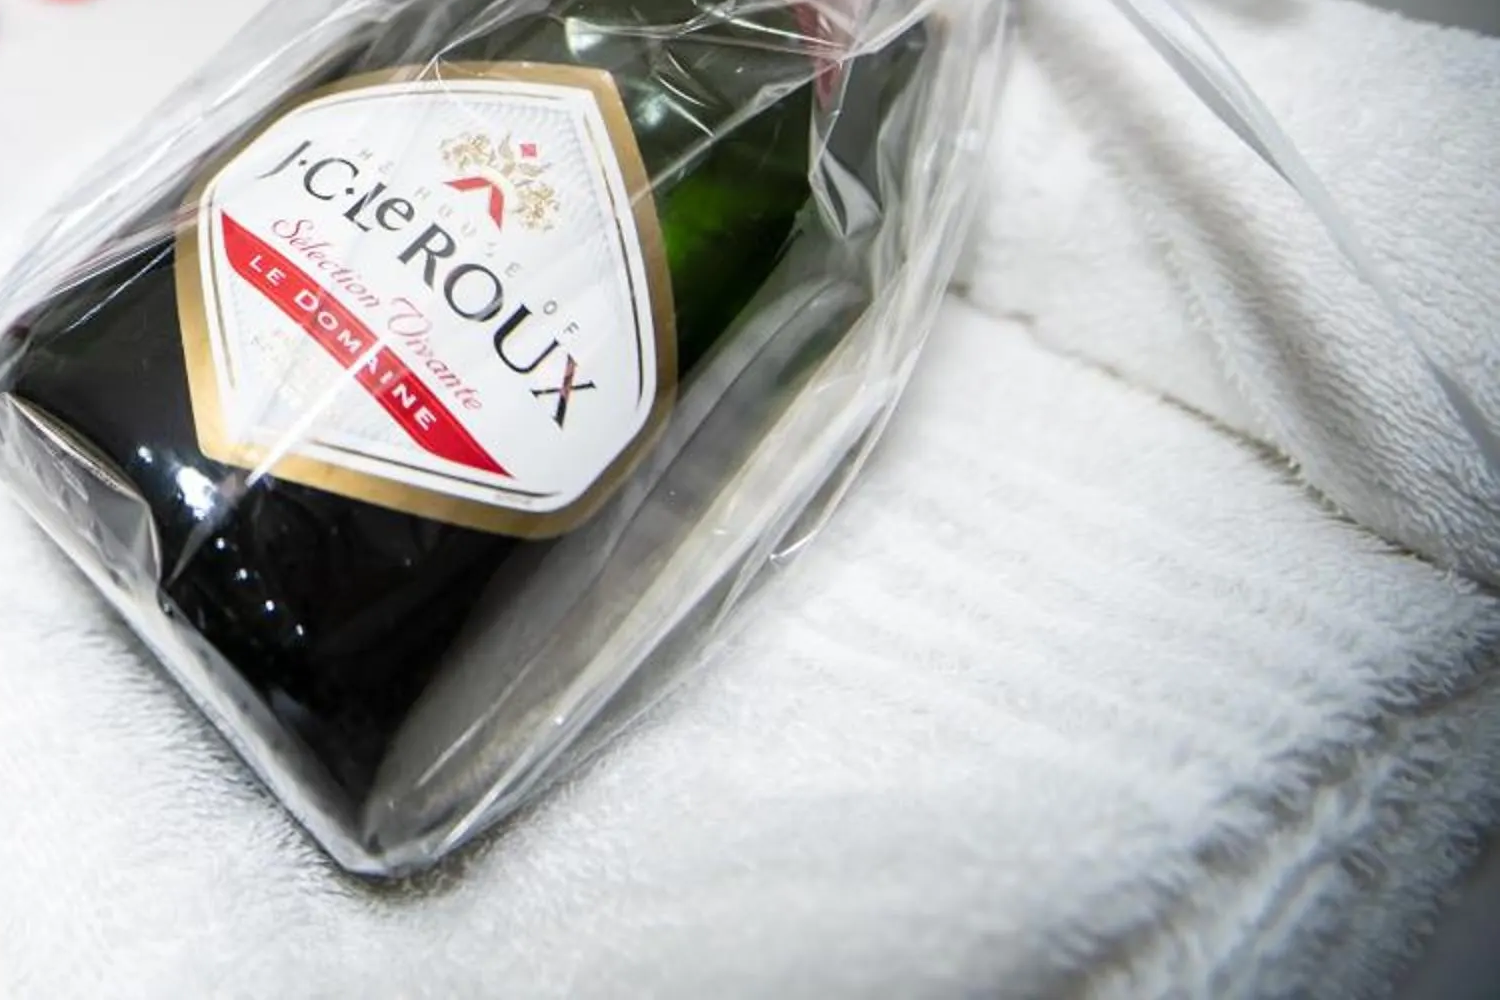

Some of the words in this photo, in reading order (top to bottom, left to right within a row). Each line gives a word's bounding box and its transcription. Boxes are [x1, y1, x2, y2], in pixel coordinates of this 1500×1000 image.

[248, 254, 287, 287] LE
[386, 297, 484, 412] Vivante
[396, 222, 597, 430] ROUX
[542, 299, 580, 335] OF
